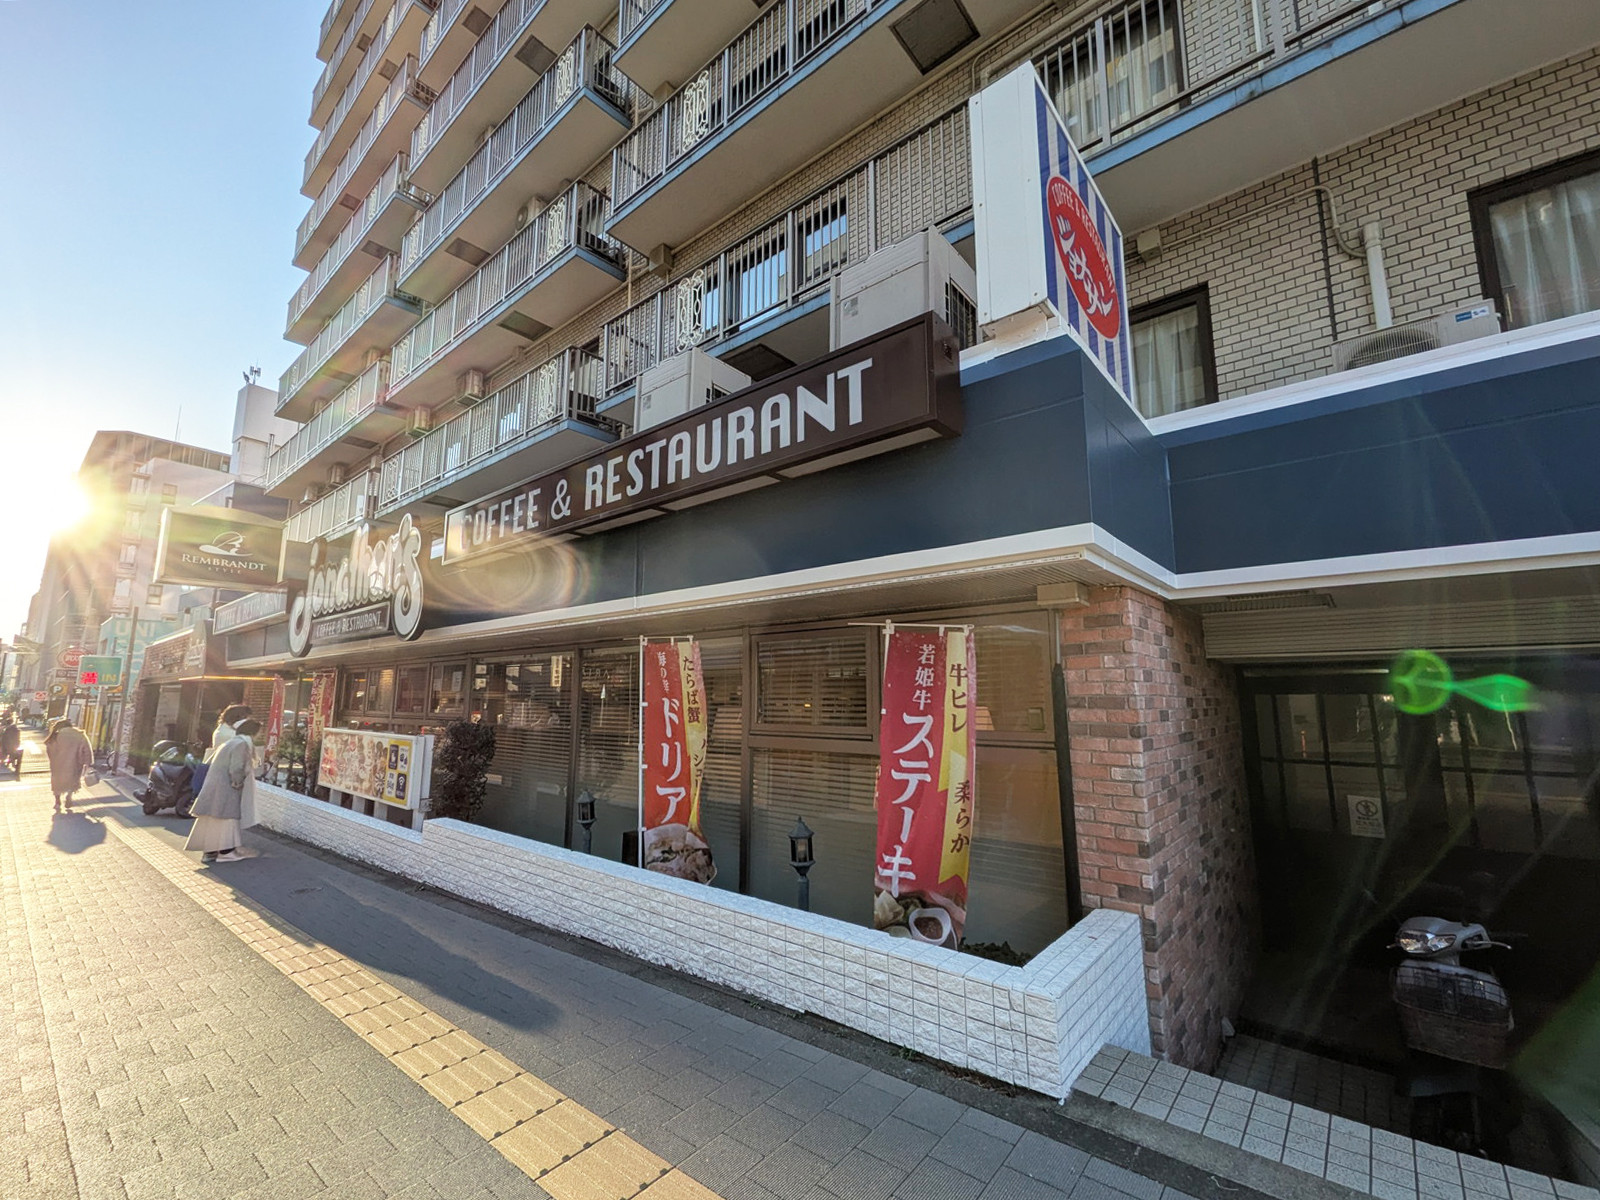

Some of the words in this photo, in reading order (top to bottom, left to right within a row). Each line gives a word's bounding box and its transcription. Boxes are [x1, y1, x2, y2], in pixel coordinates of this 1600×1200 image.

[1051, 182, 1075, 212] COFFEE
[1080, 207, 1117, 294] RESTAURANT
[458, 486, 542, 552] COFFEE
[549, 477, 572, 521] &
[583, 356, 874, 514] RESTAURANT
[181, 552, 269, 571] REMBRANDT
[316, 620, 336, 638] COFFEE
[341, 610, 382, 633] RESTAURANT
[682, 655, 701, 724] たらば蟹
[911, 642, 936, 712] 若姫牛
[948, 662, 969, 734] 牛ヒレ
[655, 696, 687, 825] ドリア
[877, 711, 935, 899] ステーキ
[950, 779, 971, 855] 柔らか
